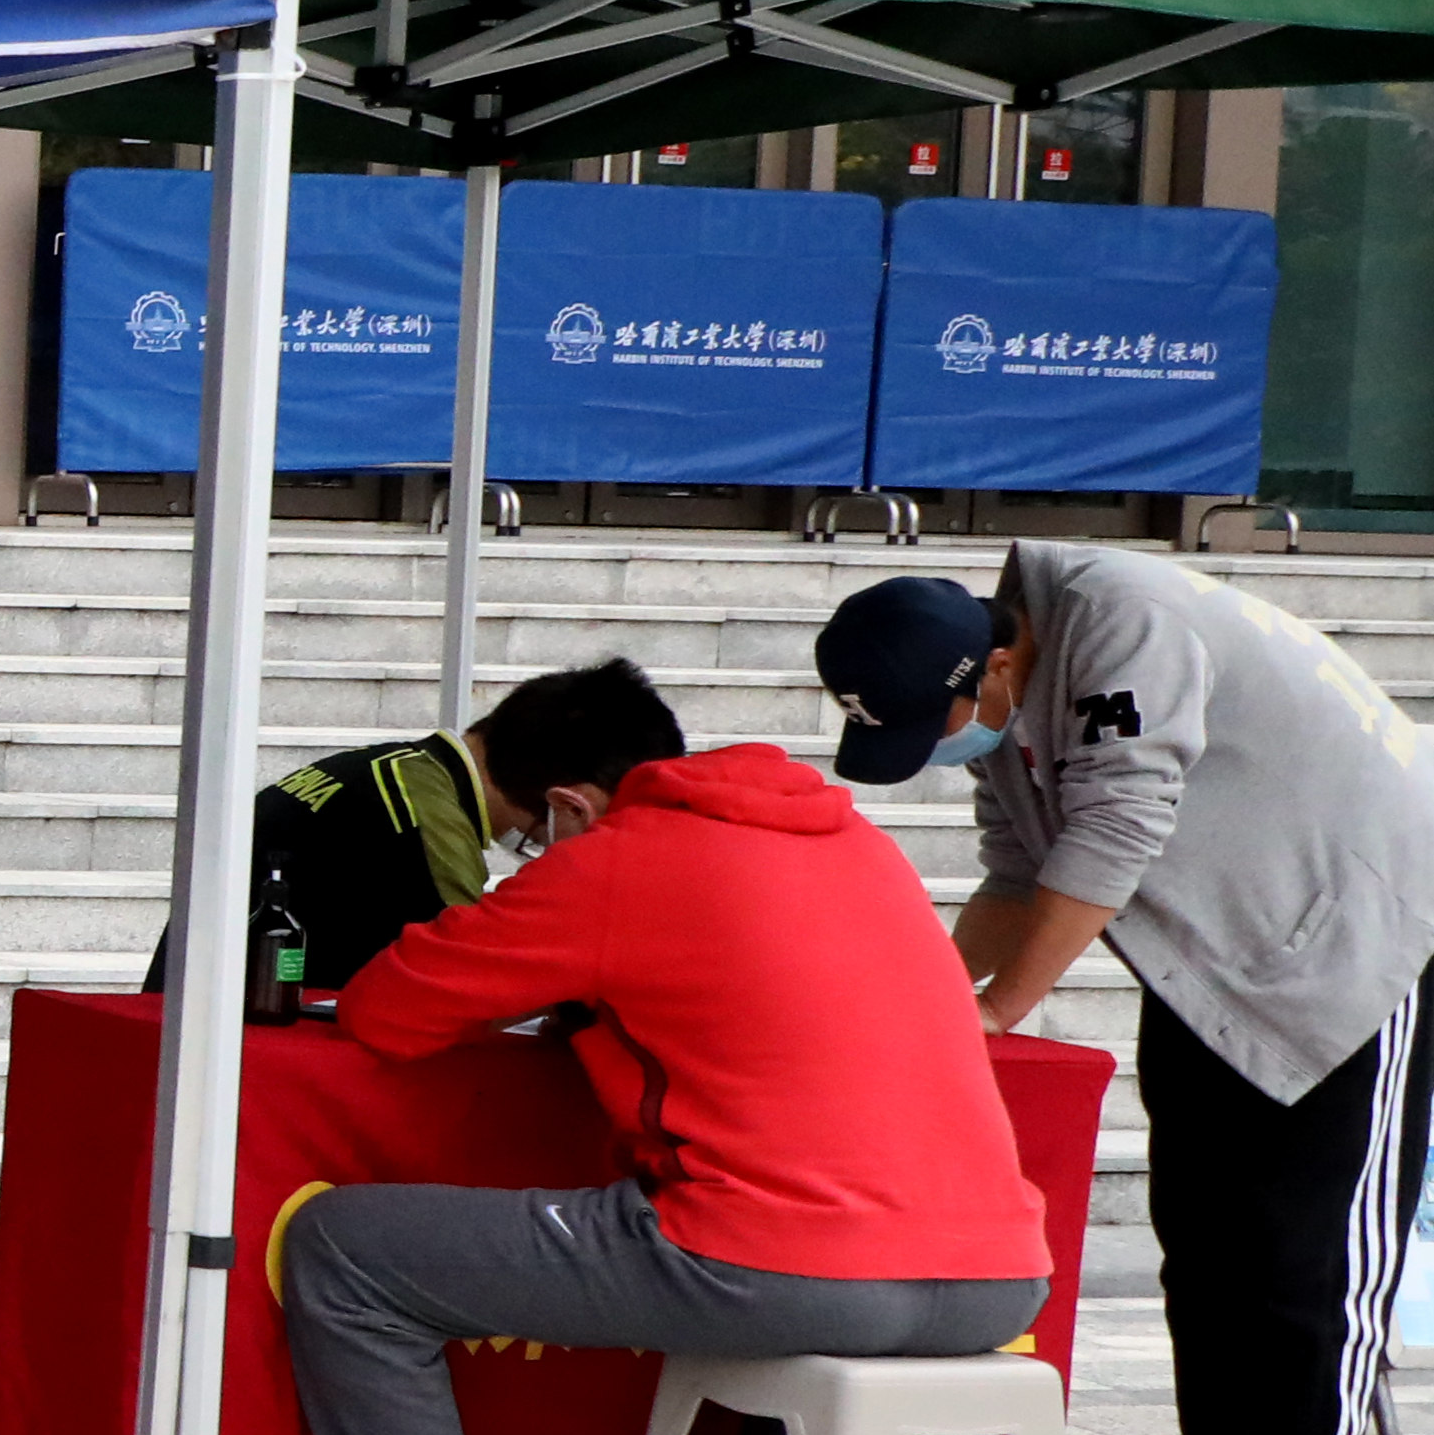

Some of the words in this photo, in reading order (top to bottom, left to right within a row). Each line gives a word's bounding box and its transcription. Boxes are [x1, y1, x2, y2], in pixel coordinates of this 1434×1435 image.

[916, 145, 931, 162] 拉
[293, 341, 306, 353] OF
[379, 342, 431, 354] SHENZHEN
[612, 353, 647, 364] HARBIN
[650, 354, 695, 365] INSTITUTE
[698, 355, 711, 366] OF
[776, 357, 823, 368] SHENZHEN
[1002, 363, 1036, 375] HARBIN
[1039, 364, 1085, 376] INSTITUTE
[1088, 366, 1100, 377] OF
[1167, 368, 1216, 381] SHENZHEN
[275, 765, 344, 813] HINA
